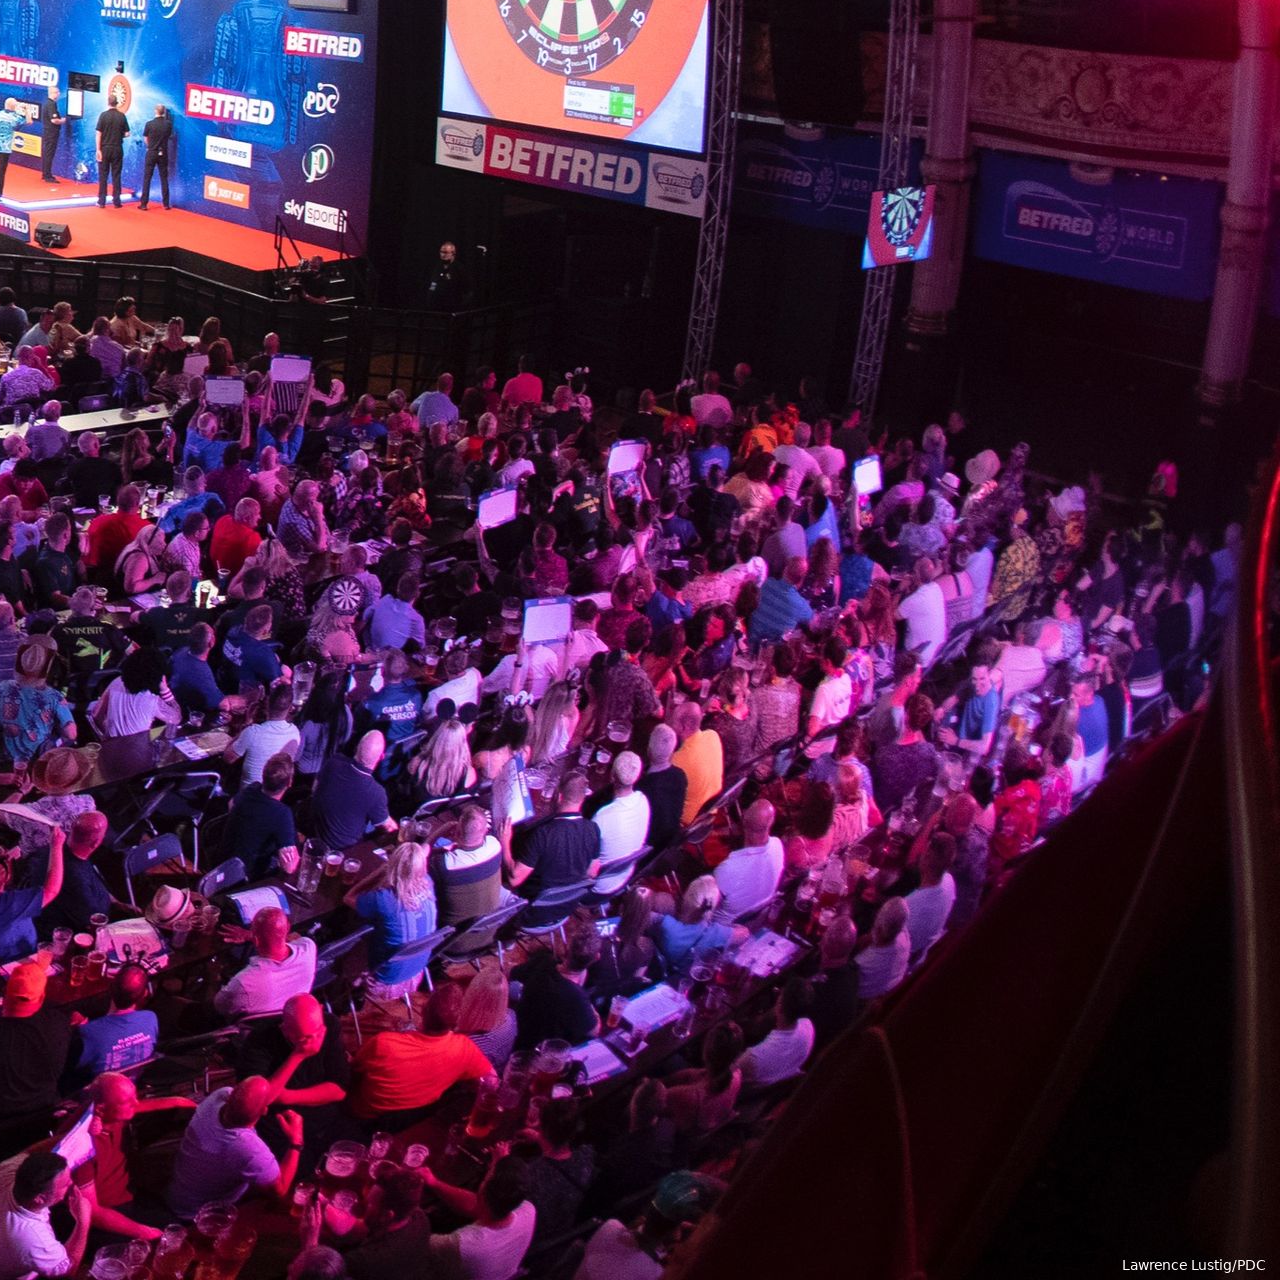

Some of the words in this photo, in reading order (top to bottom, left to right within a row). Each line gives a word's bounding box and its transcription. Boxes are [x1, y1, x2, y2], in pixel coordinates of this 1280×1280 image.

[100, 8, 147, 21] MATCHPLAY
[630, 8, 646, 29] 15
[287, 30, 362, 58] BETFRED
[515, 29, 528, 44] 7
[612, 36, 625, 55] 2
[537, 47, 549, 66] 19
[586, 52, 598, 71] 17
[563, 58, 572, 75] 3
[188, 88, 275, 126] BETFRED
[306, 91, 337, 114] PDC
[489, 134, 641, 195] BETFRED
[284, 199, 305, 220] sky
[381, 704, 403, 715] GARY
